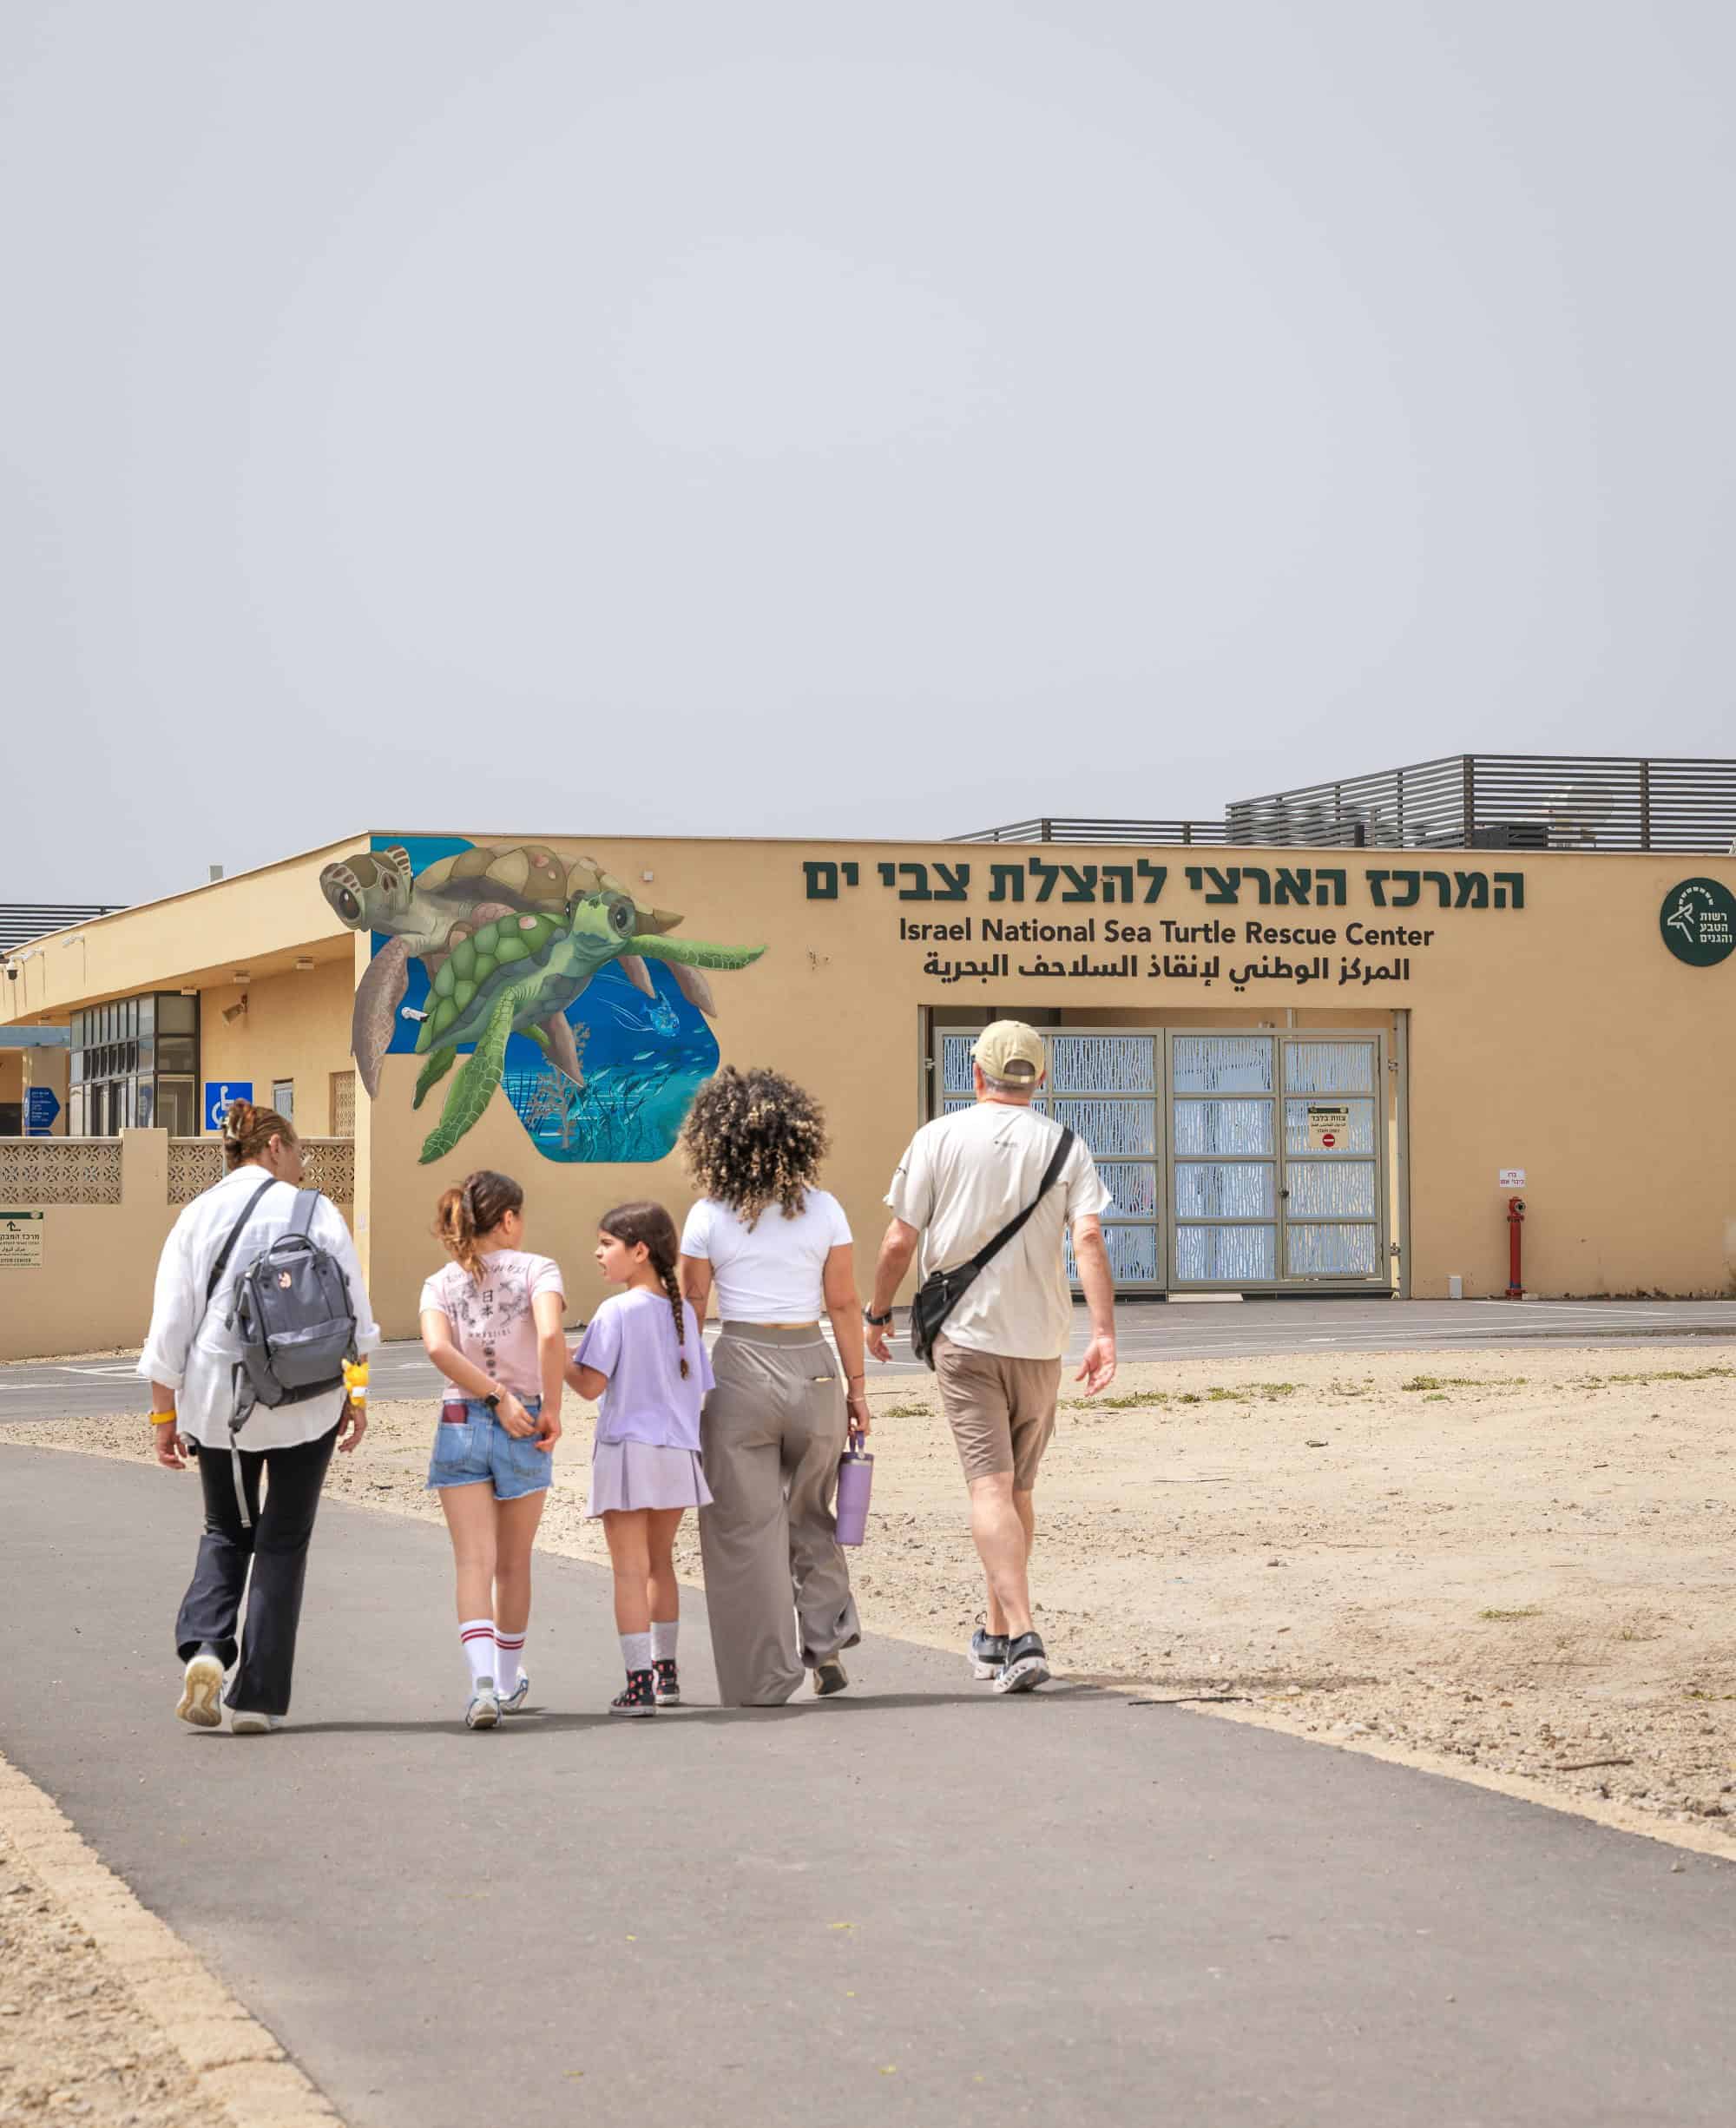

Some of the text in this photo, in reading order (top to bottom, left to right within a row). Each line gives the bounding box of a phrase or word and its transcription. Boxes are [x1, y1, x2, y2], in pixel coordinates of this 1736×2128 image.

[803, 857, 1525, 909] המרכז הארצי להצלת צבי ים
[1700, 912, 1727, 921] רשות
[899, 917, 1435, 946] Israel National Sea Turtle Rescue Center
[1700, 923, 1728, 932] הטבע
[1700, 934, 1733, 943] והגנים
[923, 951, 1410, 992] المركز الوطني لإنقاذ السلاحف البحرية
